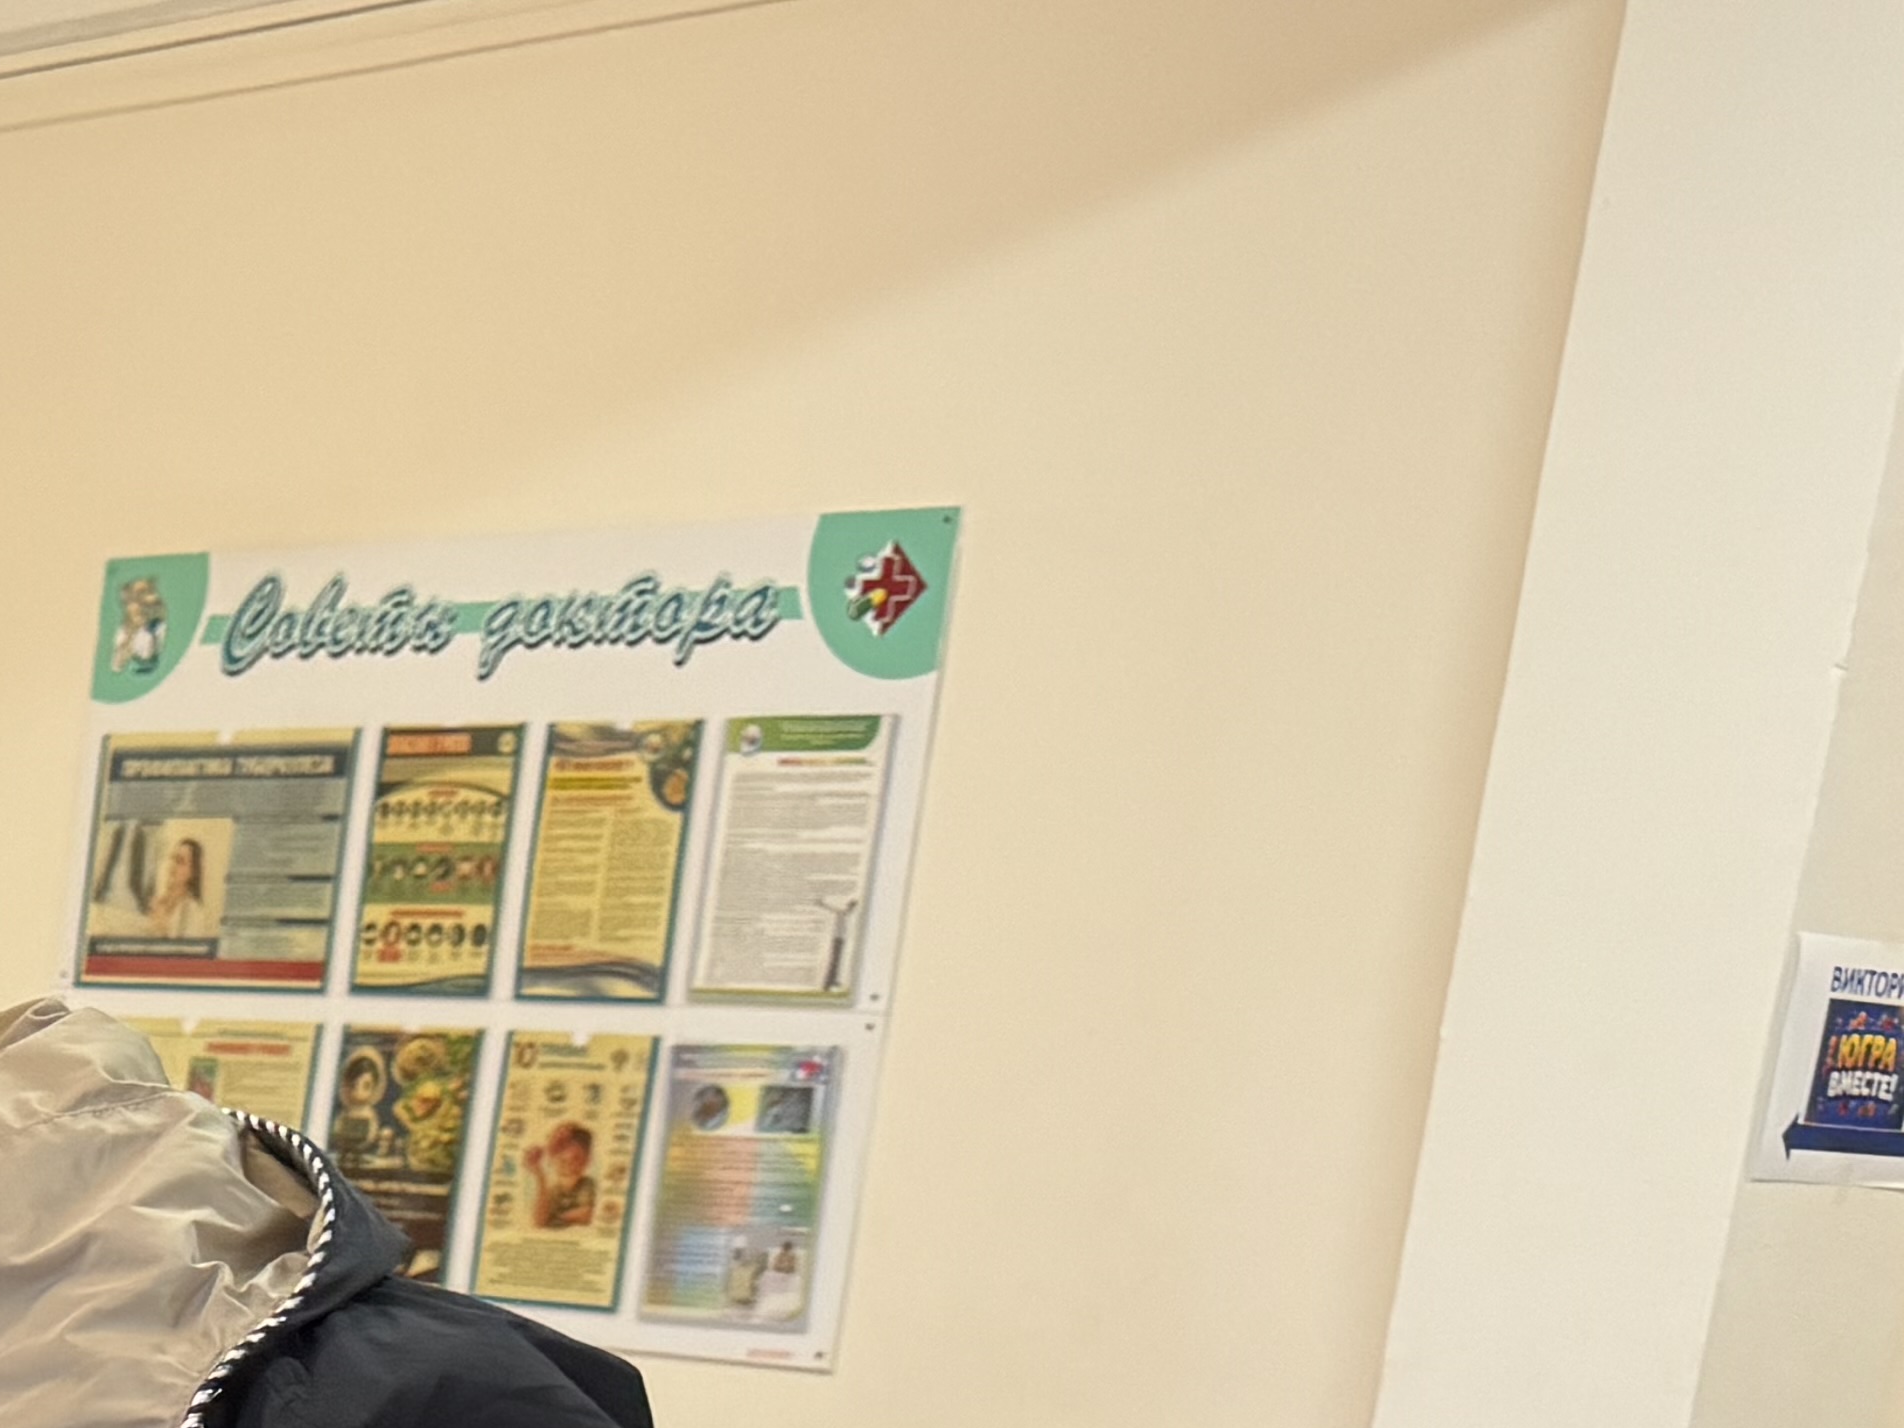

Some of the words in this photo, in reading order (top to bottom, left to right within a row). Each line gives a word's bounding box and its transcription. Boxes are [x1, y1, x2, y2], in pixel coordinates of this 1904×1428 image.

[220, 570, 460, 677] Советы
[475, 571, 782, 681] доктора
[1836, 1034, 1897, 1071] ЮГРА
[1827, 1070, 1899, 1101] ВМЕСТЕ!
